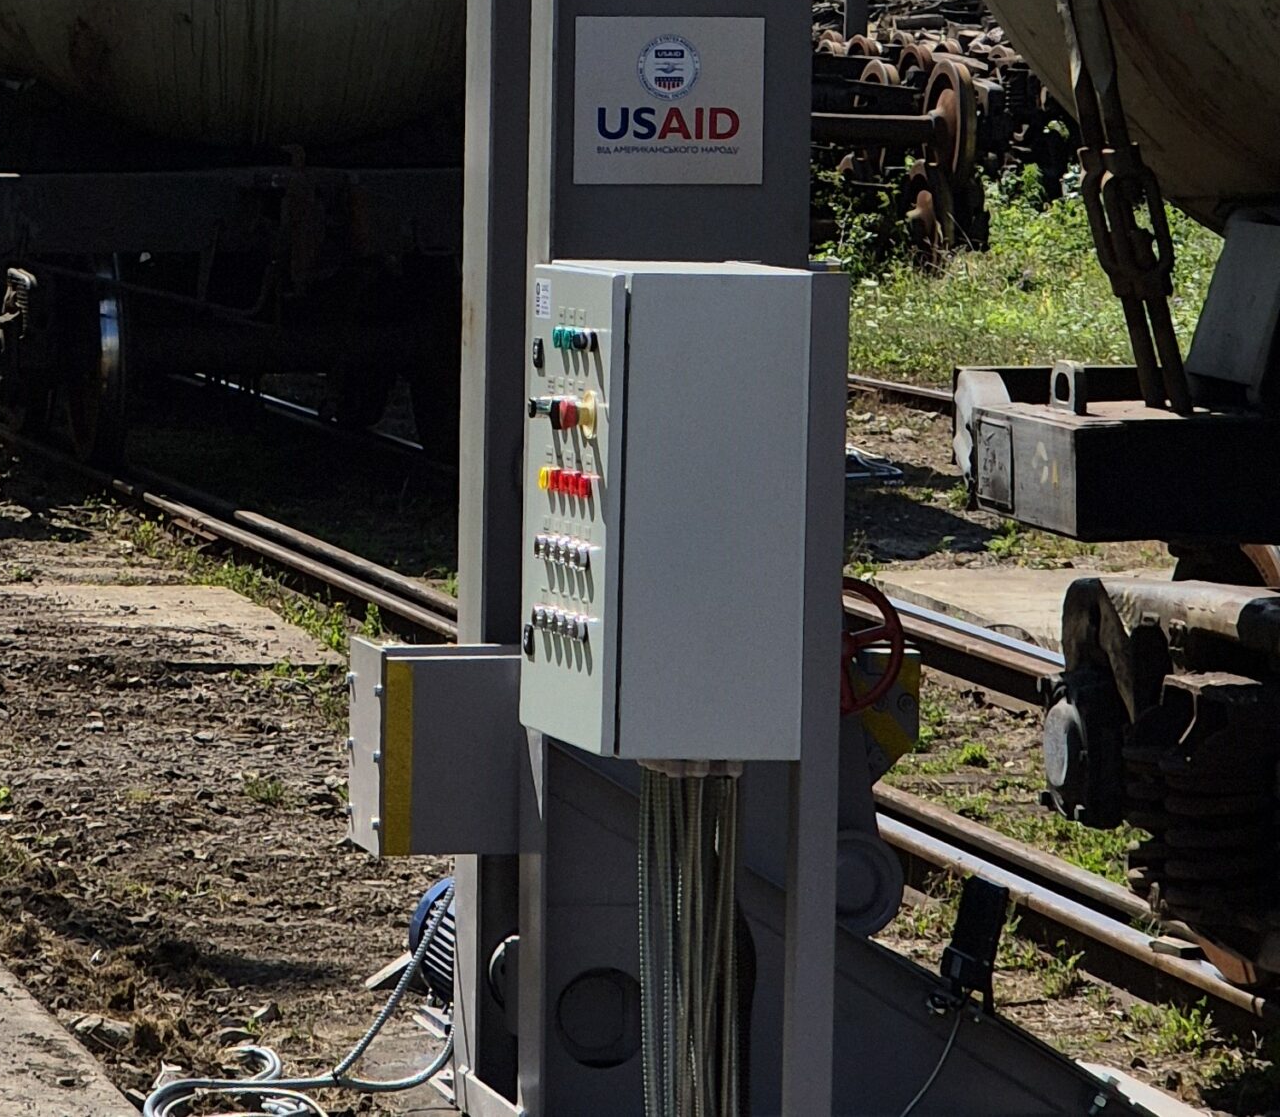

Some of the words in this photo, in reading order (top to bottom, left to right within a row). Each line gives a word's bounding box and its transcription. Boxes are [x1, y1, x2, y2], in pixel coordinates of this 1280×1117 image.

[656, 50, 683, 58] USAID
[596, 106, 741, 141] USAID
[596, 146, 612, 155] ВІД
[613, 145, 699, 155] АМЕРИКАНСЬКОГО
[700, 145, 741, 155] НАРОДУ
